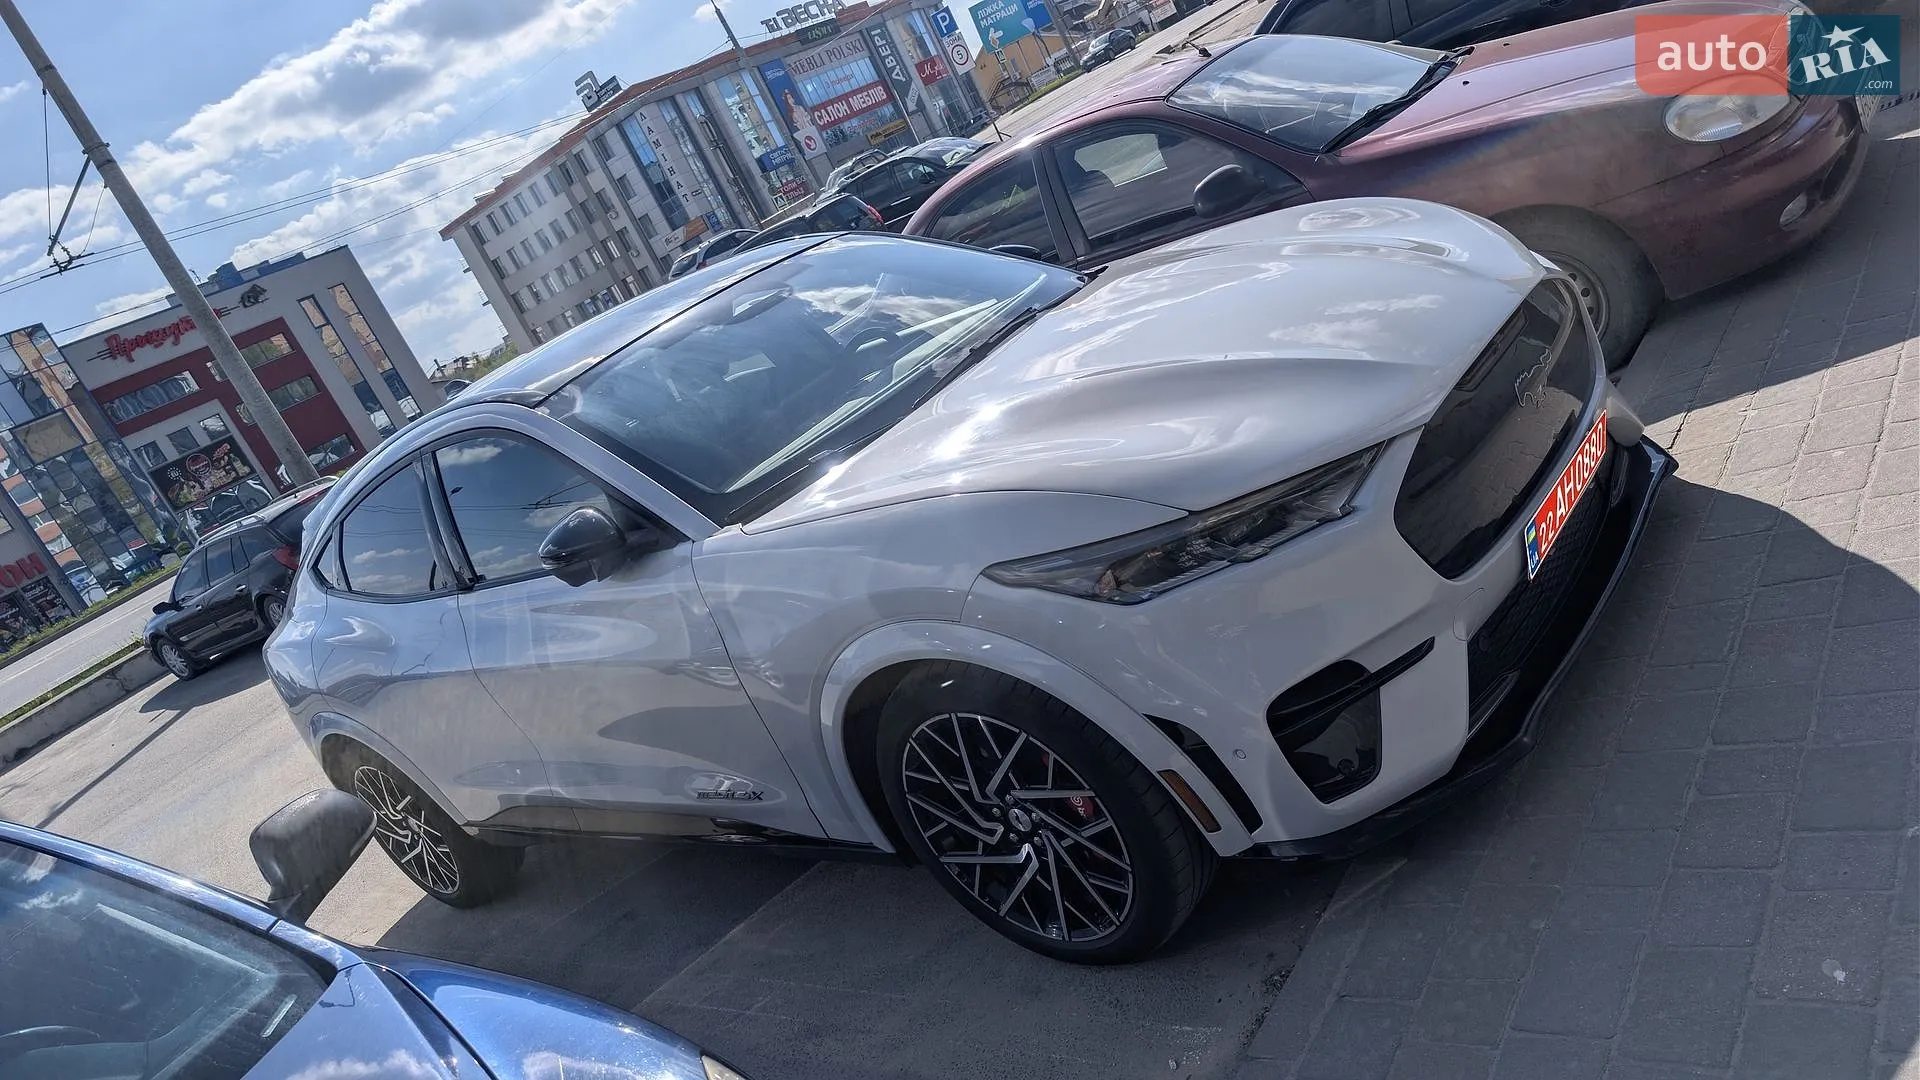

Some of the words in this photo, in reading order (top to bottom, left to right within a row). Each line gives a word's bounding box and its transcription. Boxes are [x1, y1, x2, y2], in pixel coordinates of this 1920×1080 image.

[977, 0, 1006, 19] ЛІЖКА
[980, 3, 1019, 28] МАТРАЦИ
[944, 35, 963, 49] ЗОНА
[788, 52, 827, 76] MEBLI
[826, 38, 865, 64] POLSKI
[956, 50, 964, 60] 5
[814, 101, 850, 125] САЛОН
[848, 86, 887, 112] МЕБЛІВ
[1540, 510, 1555, 553] 22
